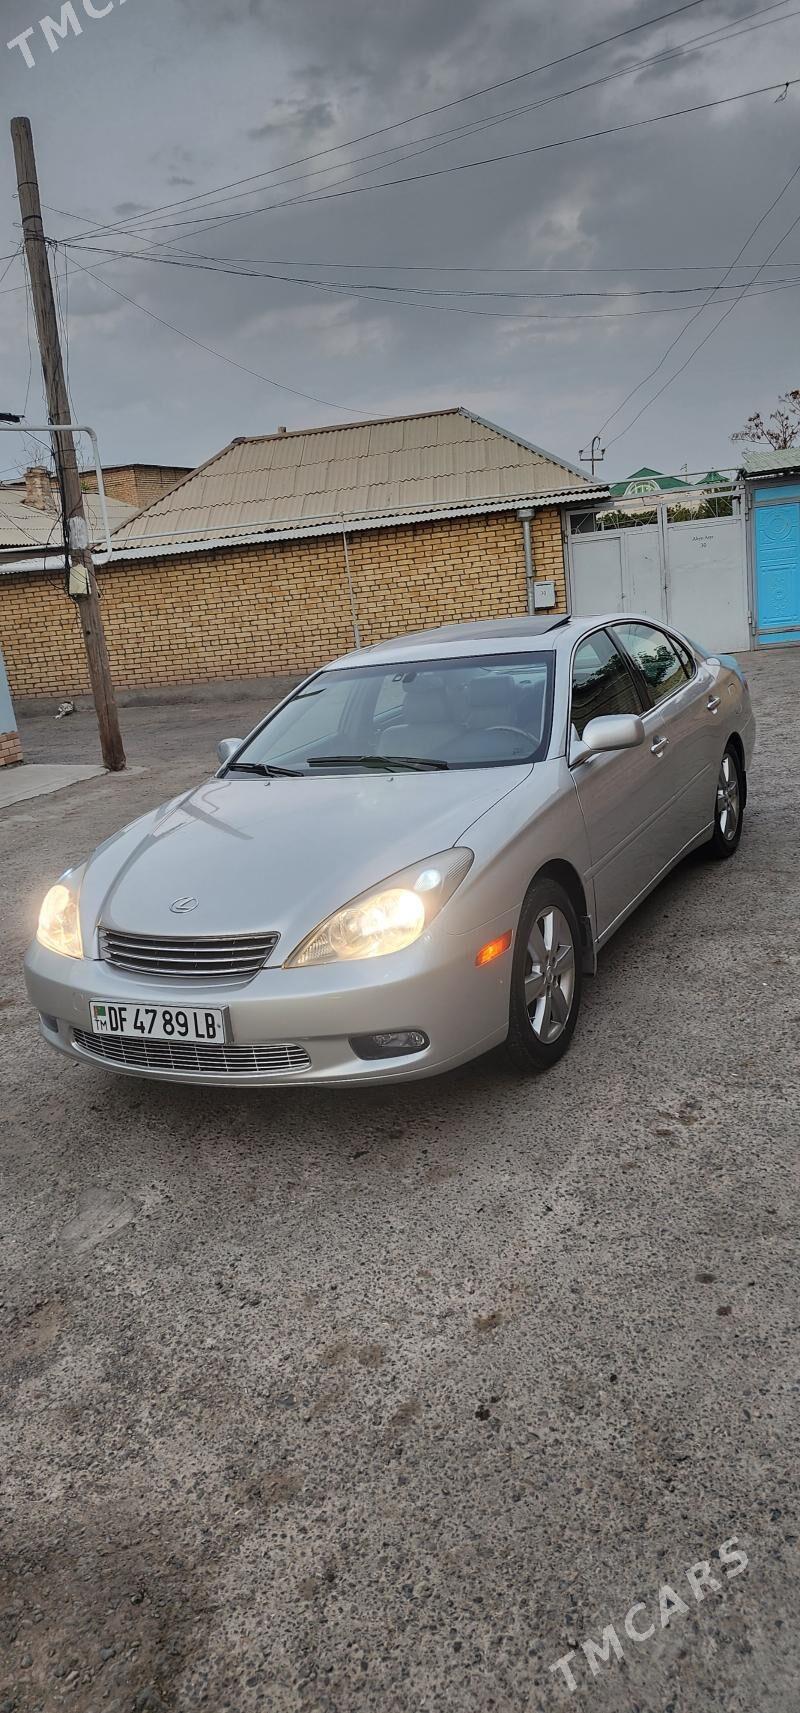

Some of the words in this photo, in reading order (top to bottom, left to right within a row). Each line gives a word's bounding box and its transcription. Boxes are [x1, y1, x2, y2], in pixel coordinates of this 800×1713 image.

[95, 1019, 107, 1031] TM
[108, 1006, 127, 1032] DF
[193, 1012, 216, 1039] LB
